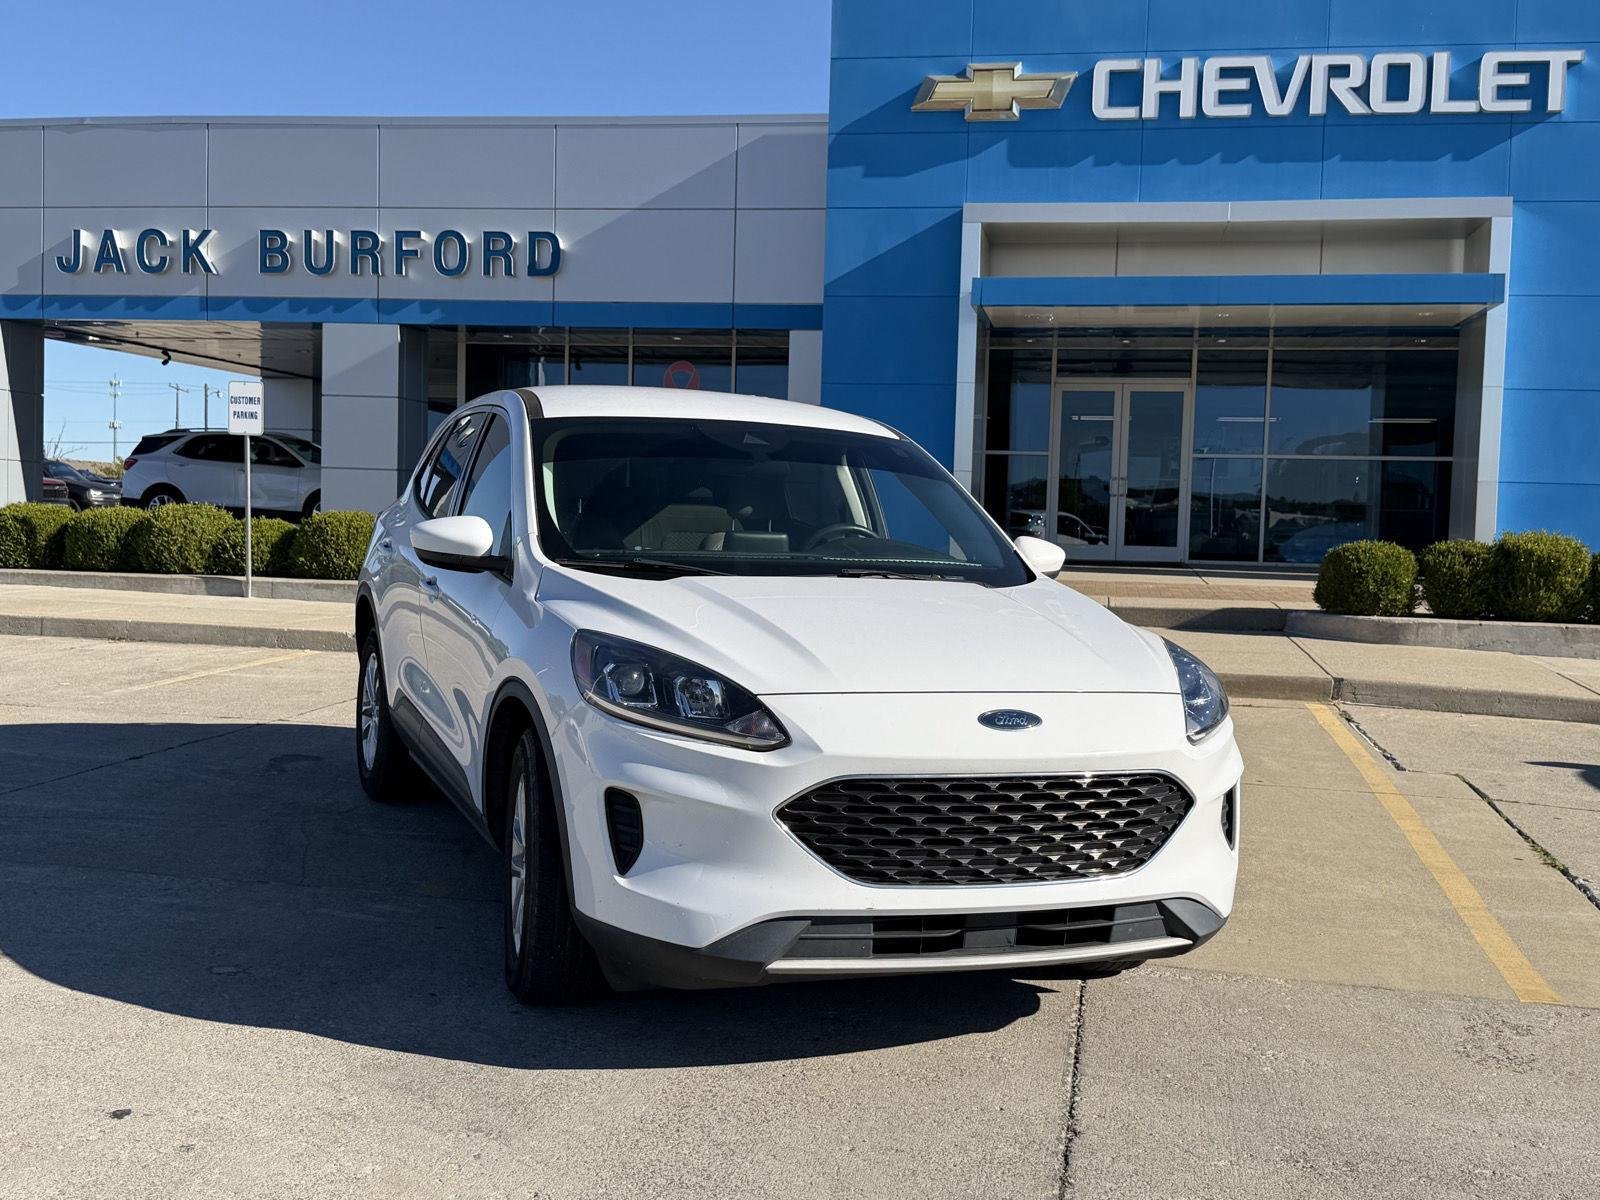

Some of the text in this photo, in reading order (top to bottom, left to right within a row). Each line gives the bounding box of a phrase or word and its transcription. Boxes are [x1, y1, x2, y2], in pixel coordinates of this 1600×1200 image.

[1092, 50, 1584, 119] CHEVROLET
[55, 228, 562, 277] JACK BURFORD
[230, 395, 261, 406] CUSTOMER
[233, 410, 258, 420] PARKING
[994, 712, 1029, 726] Ford
